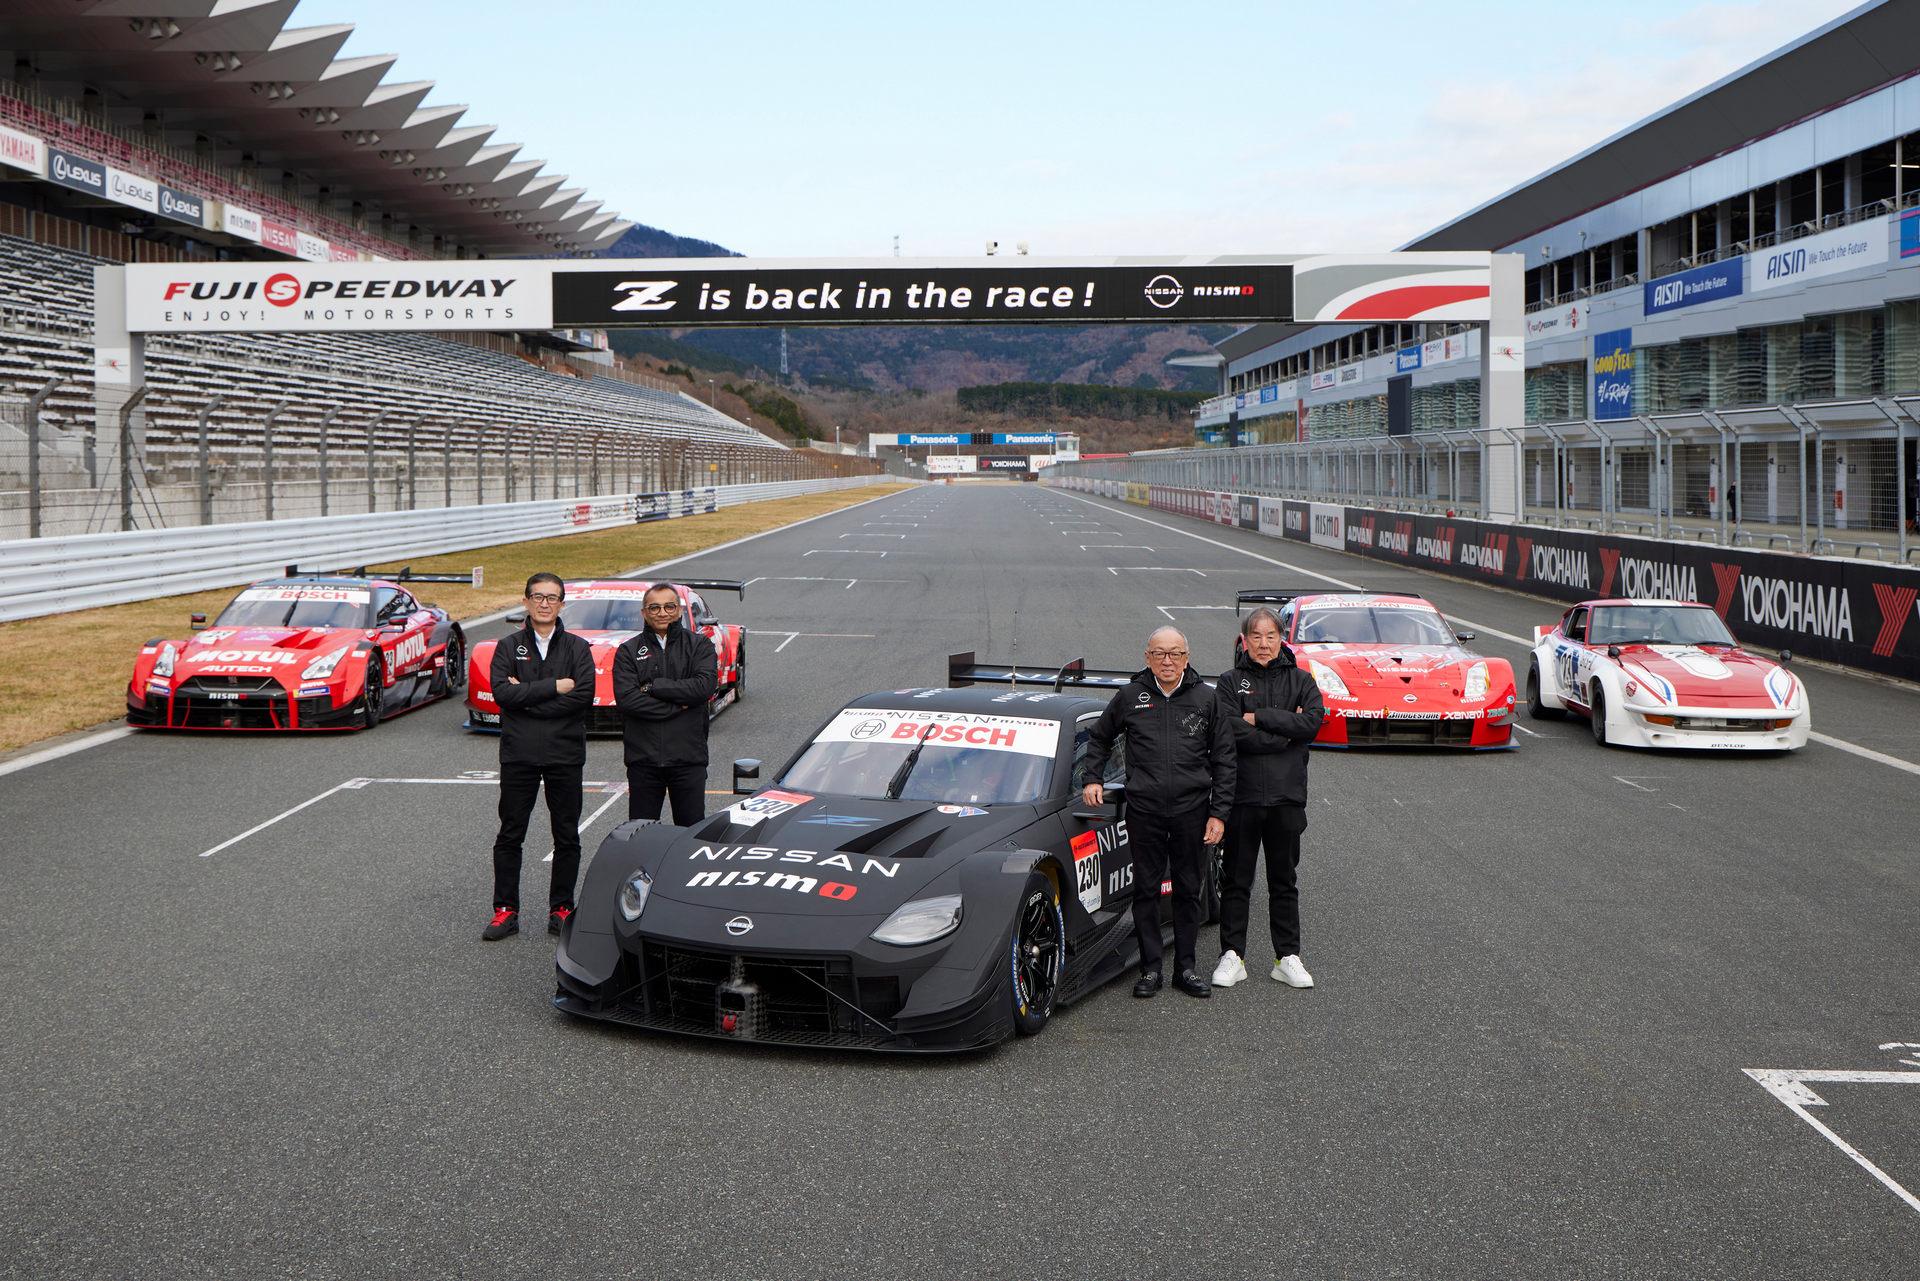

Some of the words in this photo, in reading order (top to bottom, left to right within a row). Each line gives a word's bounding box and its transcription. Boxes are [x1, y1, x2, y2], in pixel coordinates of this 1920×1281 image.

[66, 164, 102, 187] LEXUS
[124, 180, 153, 202] LEXUS
[172, 199, 200, 217] LEXUS
[1767, 248, 1805, 280] AISIN
[1818, 248, 1836, 262] Touch
[1836, 246, 1847, 258] the
[1848, 241, 1868, 257] Future
[163, 281, 259, 300] FUJI
[264, 276, 517, 304] SPEEDWAY
[611, 280, 679, 311] Z
[698, 283, 731, 310] is
[745, 282, 843, 310] back
[855, 281, 892, 309] in
[906, 281, 971, 309] the
[1193, 285, 1254, 296] nismo
[1654, 280, 1683, 308] AISIN
[1712, 276, 1728, 289] Future
[165, 310, 265, 323] ENJOY!
[304, 308, 514, 321] MOTORSPORTS
[910, 434, 958, 444] Panasonic
[1006, 433, 1054, 443] Panasonic
[991, 459, 1027, 468] YOKOHAMA
[1347, 525, 1373, 546] ADVAN
[1379, 530, 1408, 552] ADVAN
[1416, 536, 1451, 562] ADVAN
[1460, 543, 1503, 571] ADVAN
[1532, 544, 1591, 590] YOKOHAMA
[1619, 557, 1698, 603] YOKOHAMA
[280, 591, 348, 600] BOSCH
[1740, 574, 1854, 642] YOKOHAMA
[186, 651, 298, 664] MOTUL
[396, 632, 427, 668] MOTUL
[198, 665, 273, 673] AUTECH
[209, 692, 248, 700] nismo
[477, 691, 495, 702] MOTU
[889, 711, 992, 724] NISSAN
[891, 723, 1017, 747] BOSCH
[1097, 819, 1129, 856] NIS
[689, 846, 901, 878] NISSAN
[1078, 854, 1099, 894] 230
[1109, 862, 1134, 895] nis
[685, 871, 858, 901] nismo
